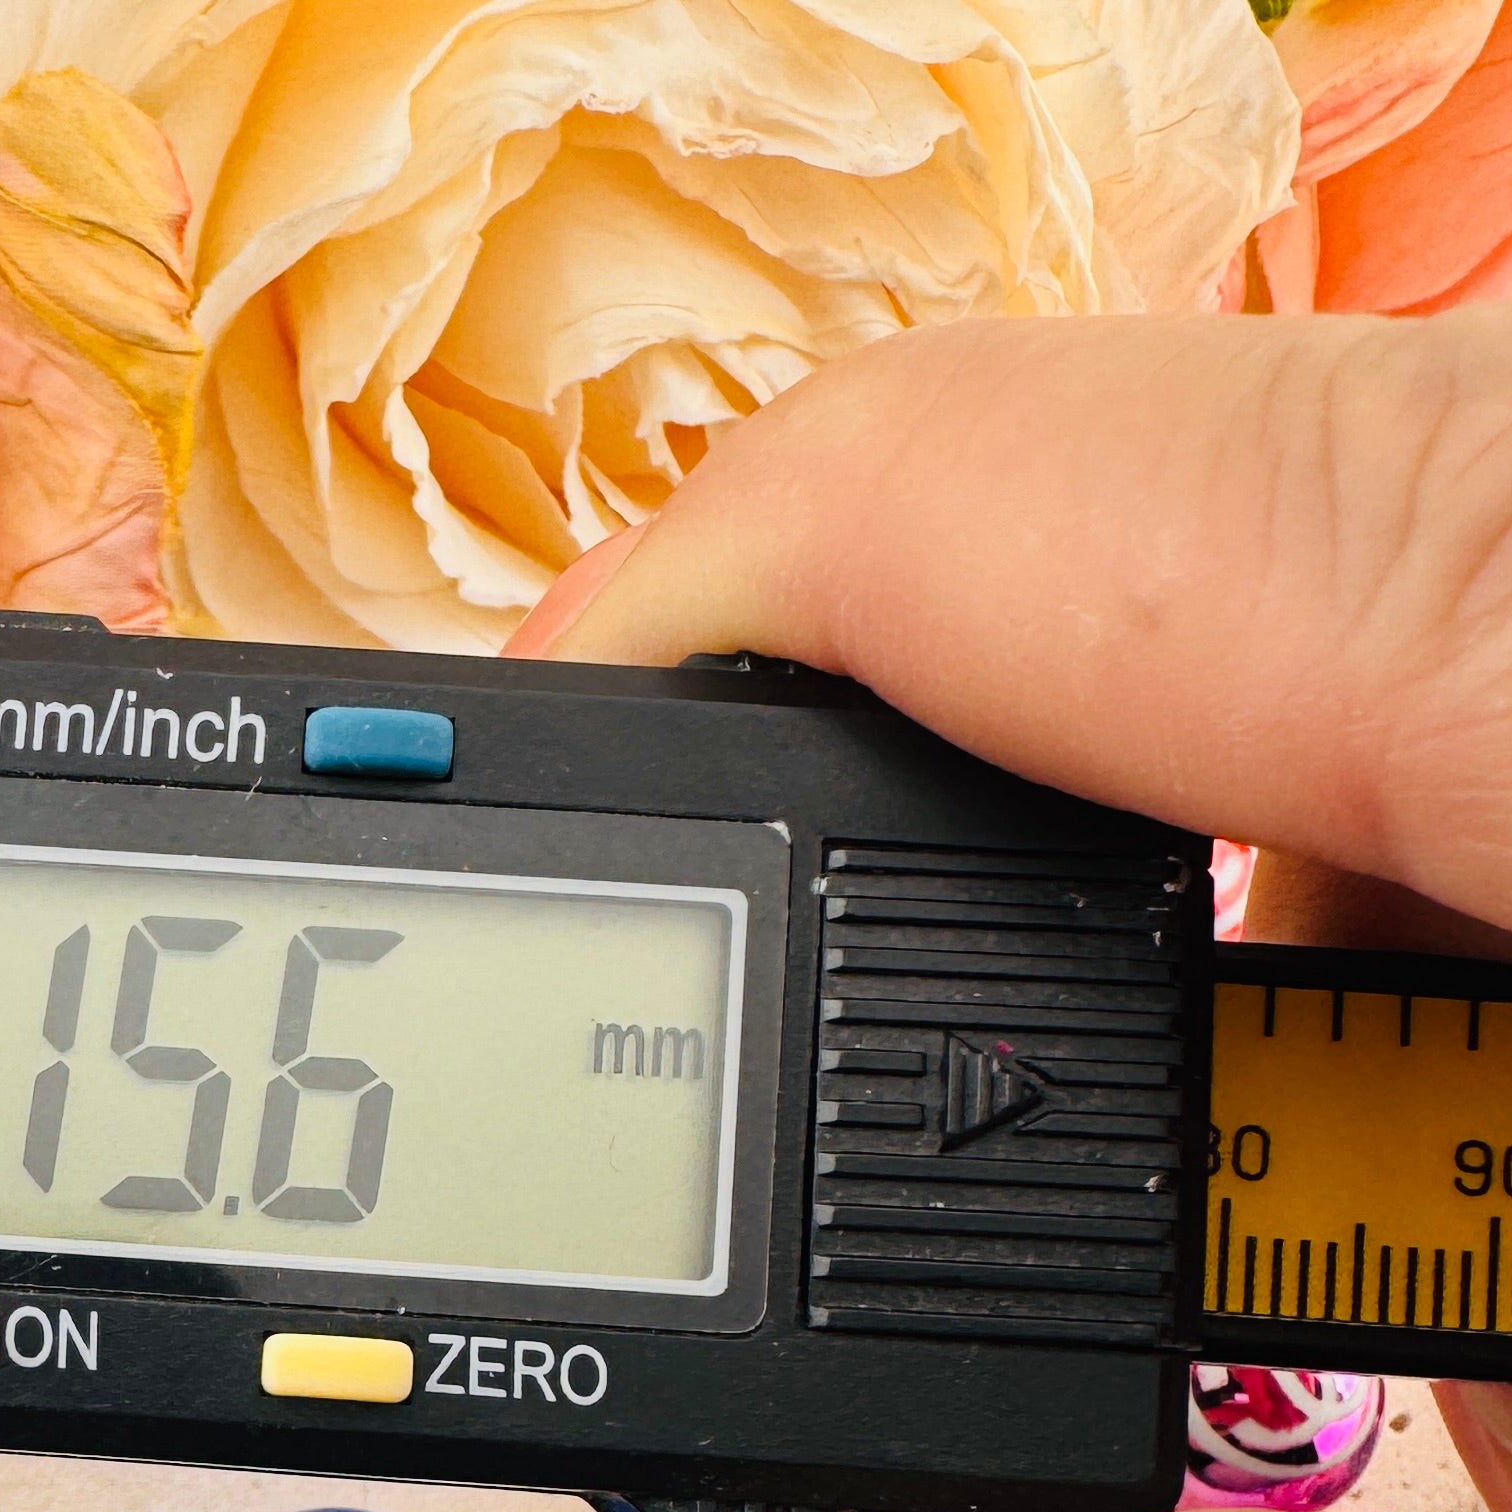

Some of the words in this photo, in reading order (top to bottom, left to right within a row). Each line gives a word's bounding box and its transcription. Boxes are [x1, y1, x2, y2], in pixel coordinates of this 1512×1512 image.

[22, 915, 406, 1223] 15.6
[592, 1020, 705, 1079] mm
[1454, 1139, 1512, 1197] 9
[5, 1306, 99, 1371] ON
[424, 1333, 609, 1407] ZERO
